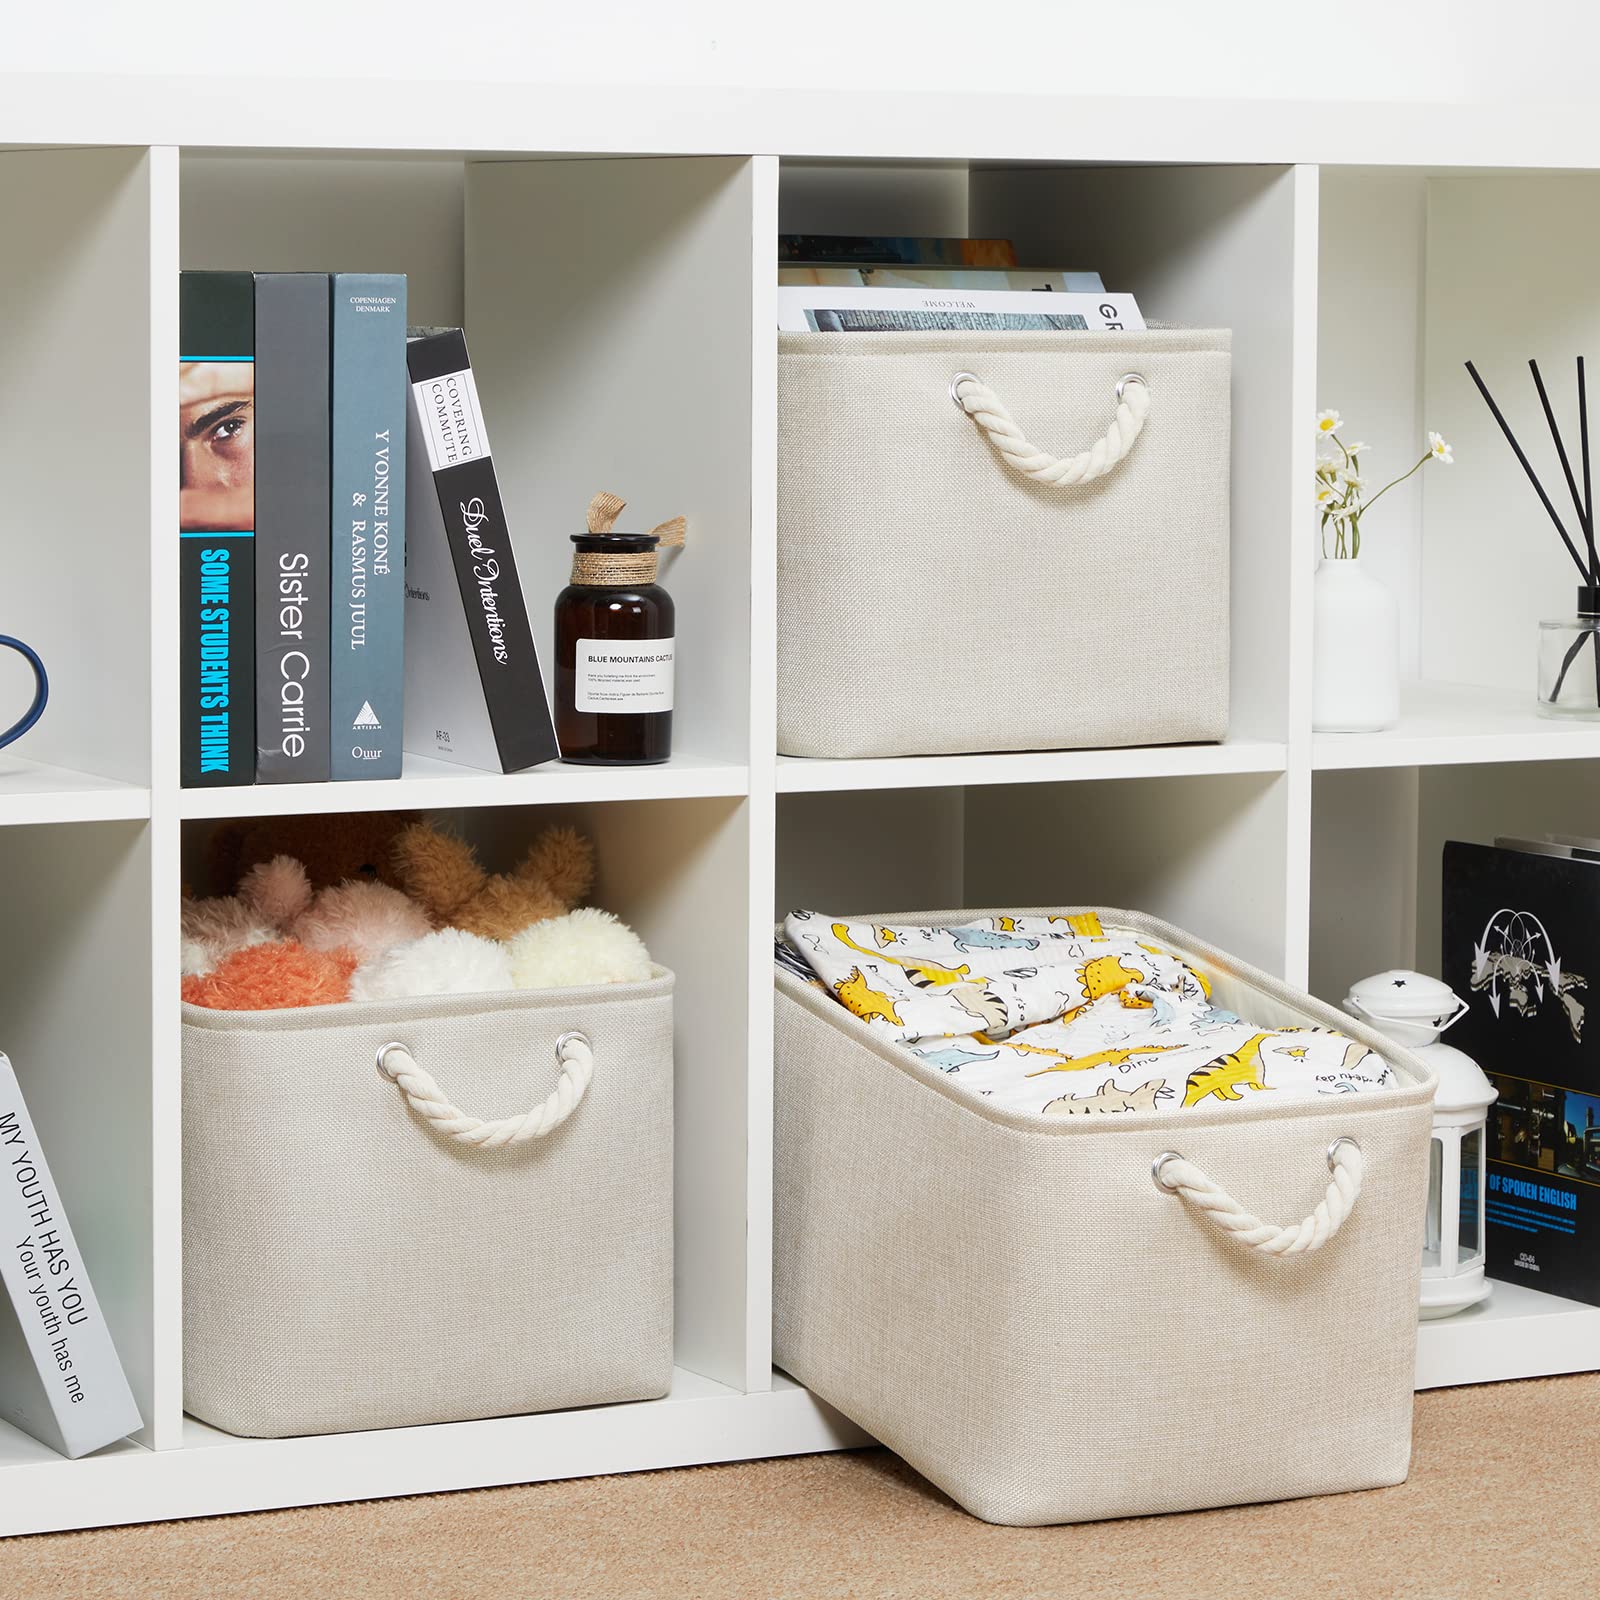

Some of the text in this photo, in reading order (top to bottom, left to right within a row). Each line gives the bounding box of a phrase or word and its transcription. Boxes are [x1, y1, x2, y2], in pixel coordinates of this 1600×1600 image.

[350, 296, 396, 304] COPENHAGEN
[355, 305, 391, 313] DENMARK
[921, 299, 976, 309] WELCOME
[431, 383, 458, 463] COMMUTE
[446, 377, 473, 456] COVERING
[349, 492, 367, 651] & RASMUS JUUL
[459, 497, 508, 665] Duel Intentions
[200, 548, 230, 774] SOME STUDENTS THINK
[279, 552, 311, 758] Sister Carrie
[588, 655, 608, 663] BLUE
[609, 655, 655, 663] MOUNTAINS
[351, 746, 382, 759] Ouur
[1118, 1056, 1159, 1074] Dino
[0, 1112, 88, 1325] MY YOUTH HAS YOU
[1489, 1174, 1502, 1191] OF
[1502, 1176, 1538, 1201] SPOKEN
[1538, 1185, 1577, 1211] ENGLISH
[16, 1235, 85, 1404] Your youth has me
